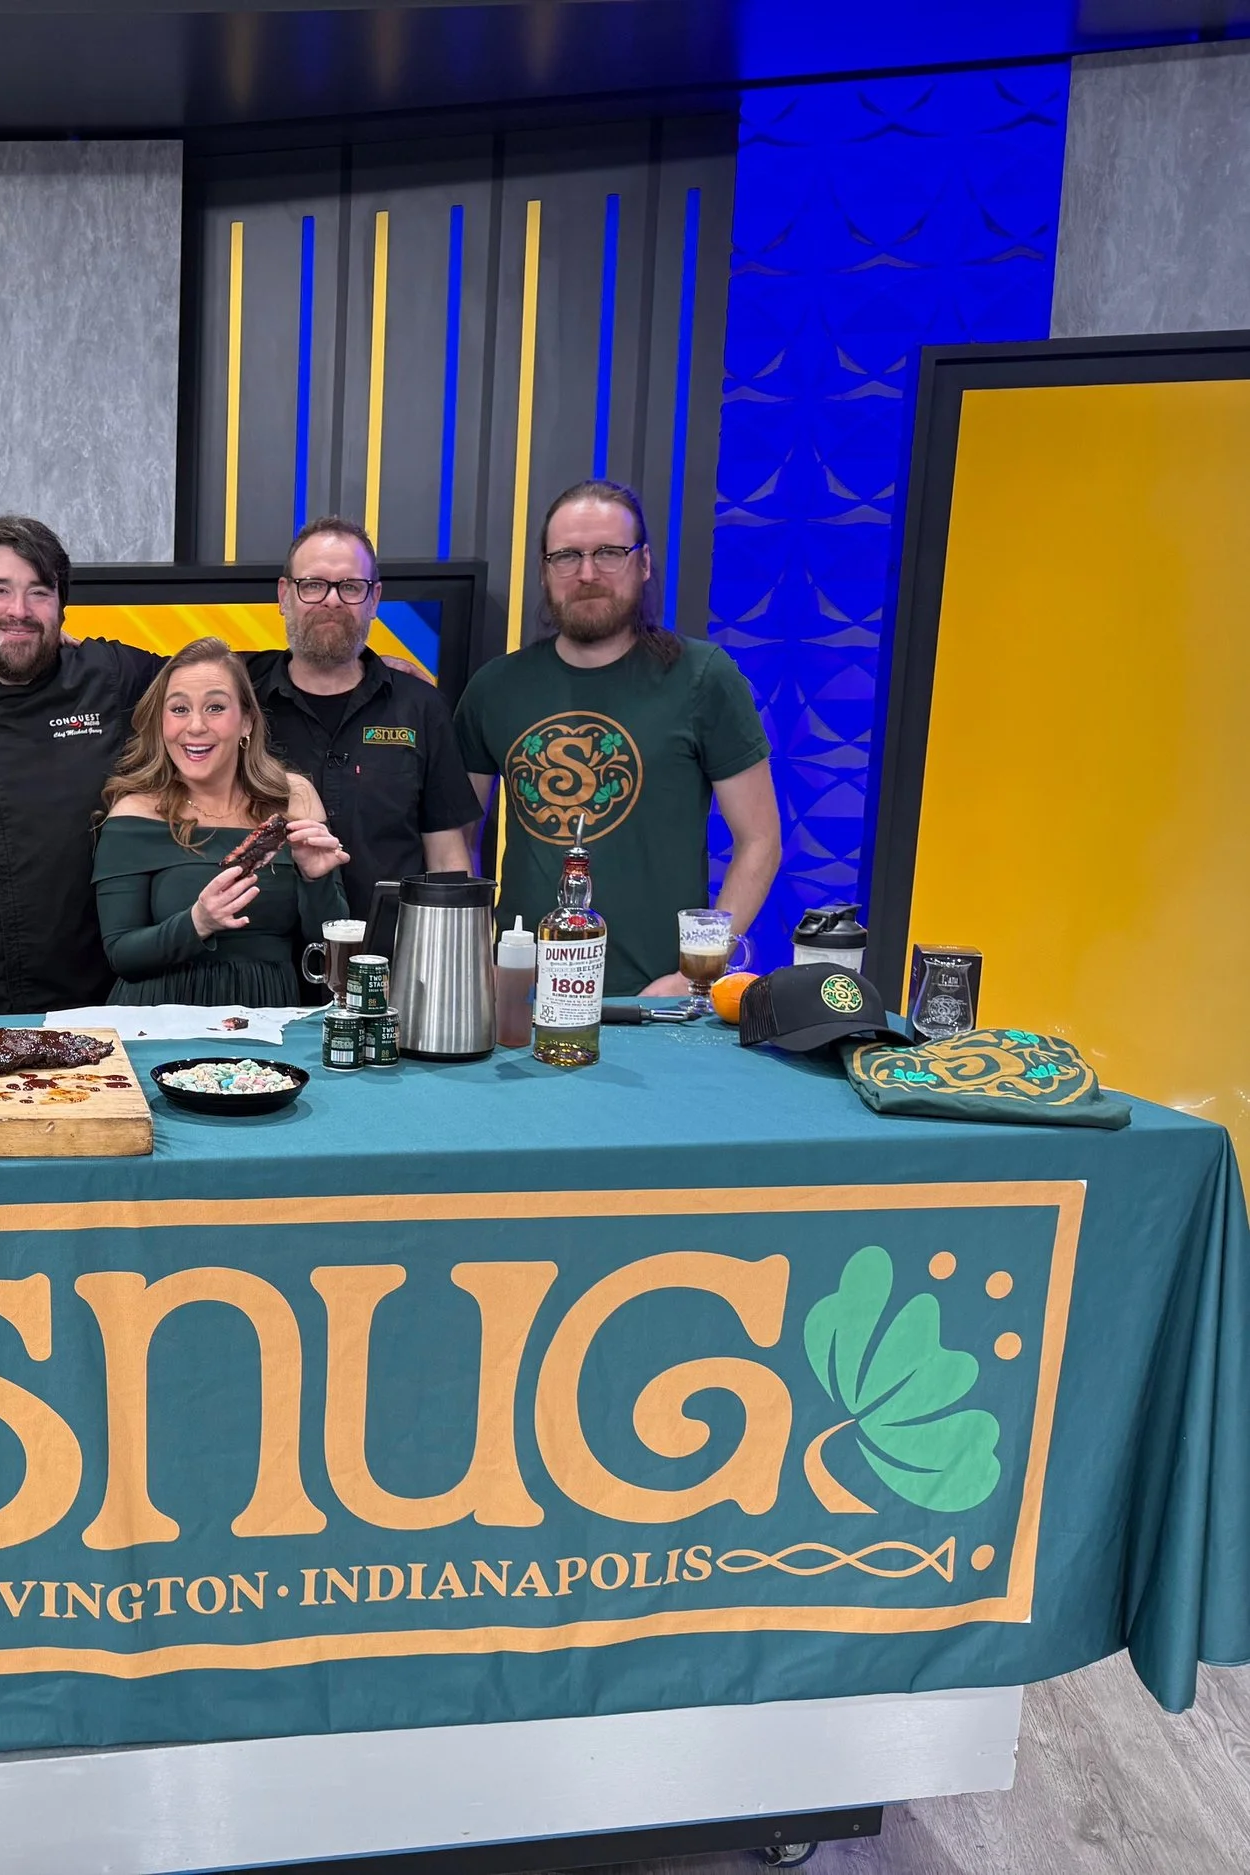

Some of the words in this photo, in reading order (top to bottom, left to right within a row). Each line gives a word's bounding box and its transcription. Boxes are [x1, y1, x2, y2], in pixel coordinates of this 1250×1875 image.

[49, 713, 100, 727] CONQUEST
[374, 729, 409, 740] SNUG
[551, 978, 595, 994] 1808
[299, 1545, 713, 1606] INDIANAPOLIS
